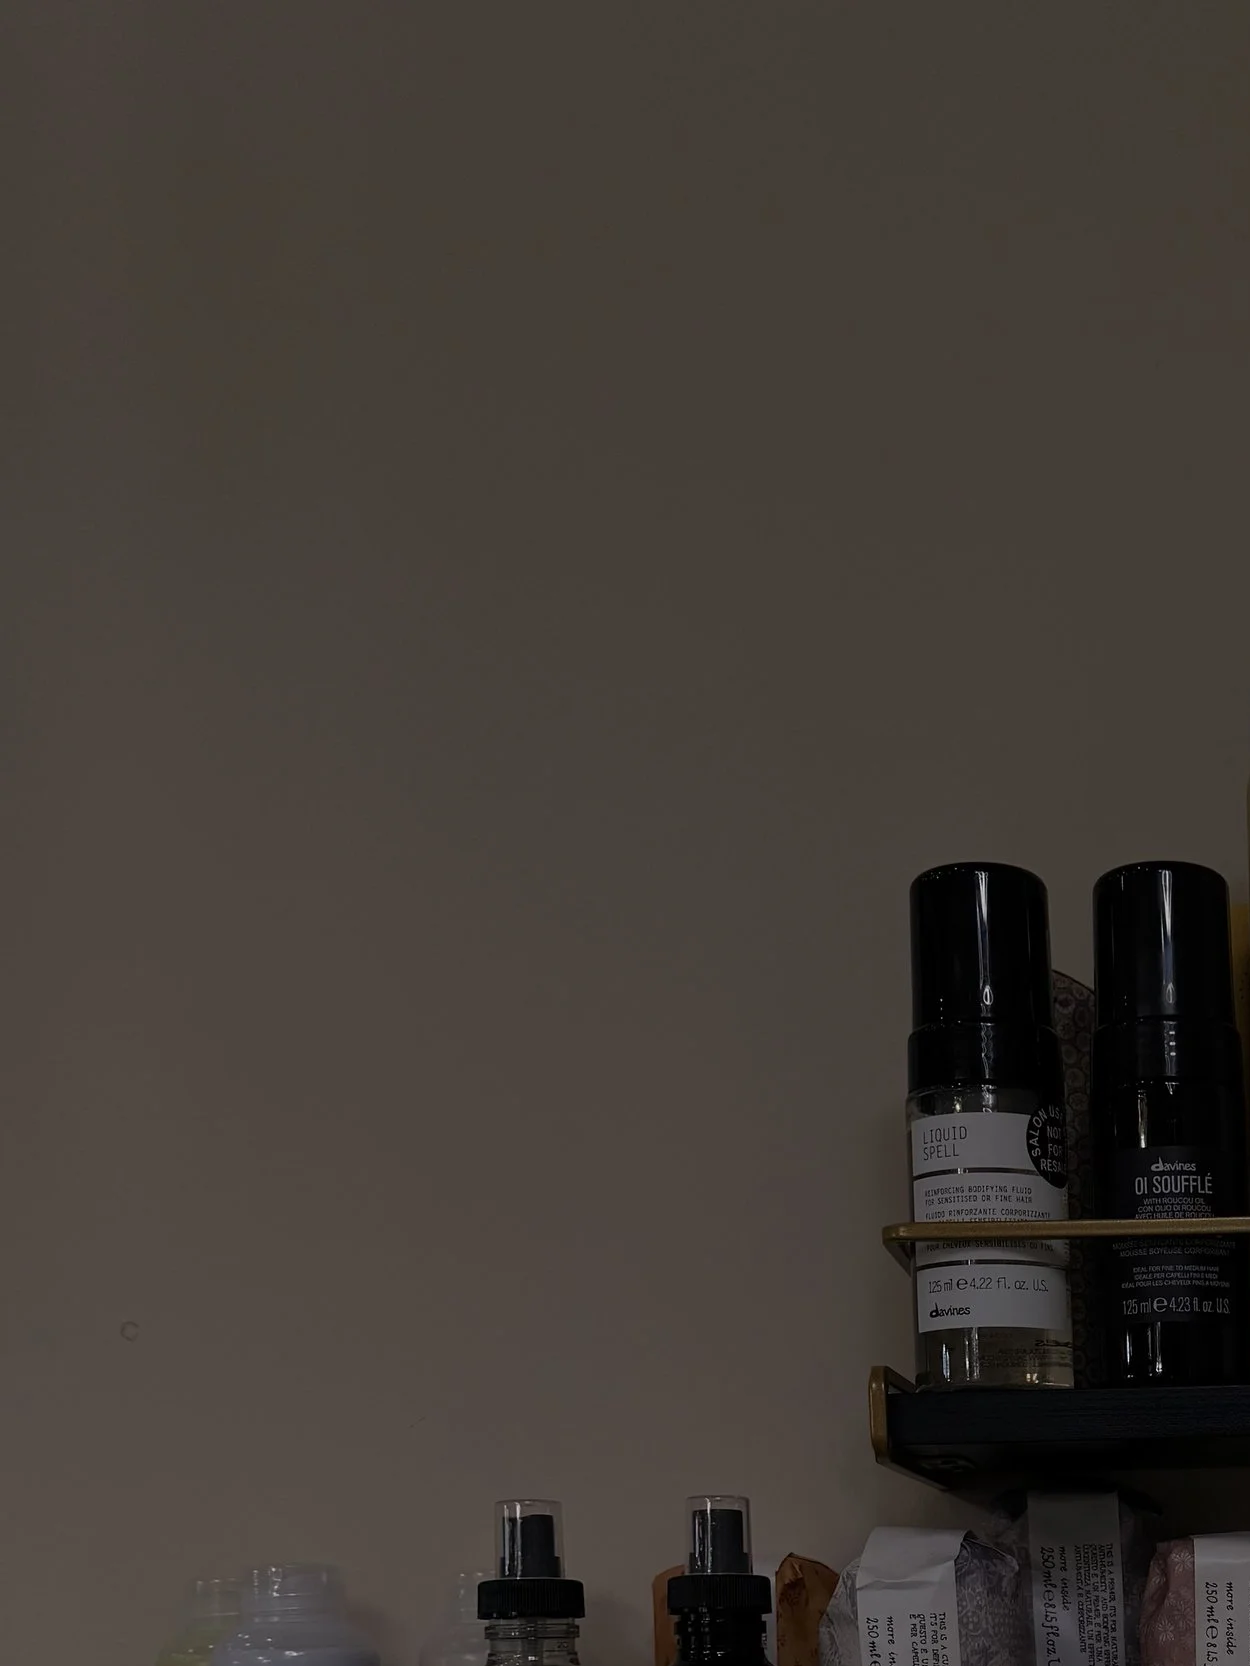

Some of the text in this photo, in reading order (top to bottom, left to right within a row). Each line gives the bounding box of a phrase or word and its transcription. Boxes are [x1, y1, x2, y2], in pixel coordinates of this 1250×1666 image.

[923, 1126, 967, 1144] LIQUID
[1029, 1108, 1048, 1157] SALON
[924, 1144, 959, 1160] SPELL
[1151, 1156, 1196, 1171] davines
[1012, 1186, 1032, 1194] FLUID
[1135, 1172, 1213, 1195] OI SOUFFLÉ
[929, 1277, 1048, 1293] 125 ml 4.22 fl. oz. U.S.
[930, 1303, 970, 1318] davines
[1123, 1300, 1138, 1315] 125
[1141, 1300, 1151, 1313] ml
[1170, 1297, 1190, 1312] 4.23
[1217, 1299, 1230, 1314] U.S.
[1041, 1547, 1056, 1588] 250 ml
[1059, 1546, 1071, 1611] more inside
[1206, 1582, 1218, 1623] 250 ml
[1226, 1582, 1236, 1655] more inside
[866, 1618, 881, 1658] 250 ml
[887, 1616, 895, 1645] more
